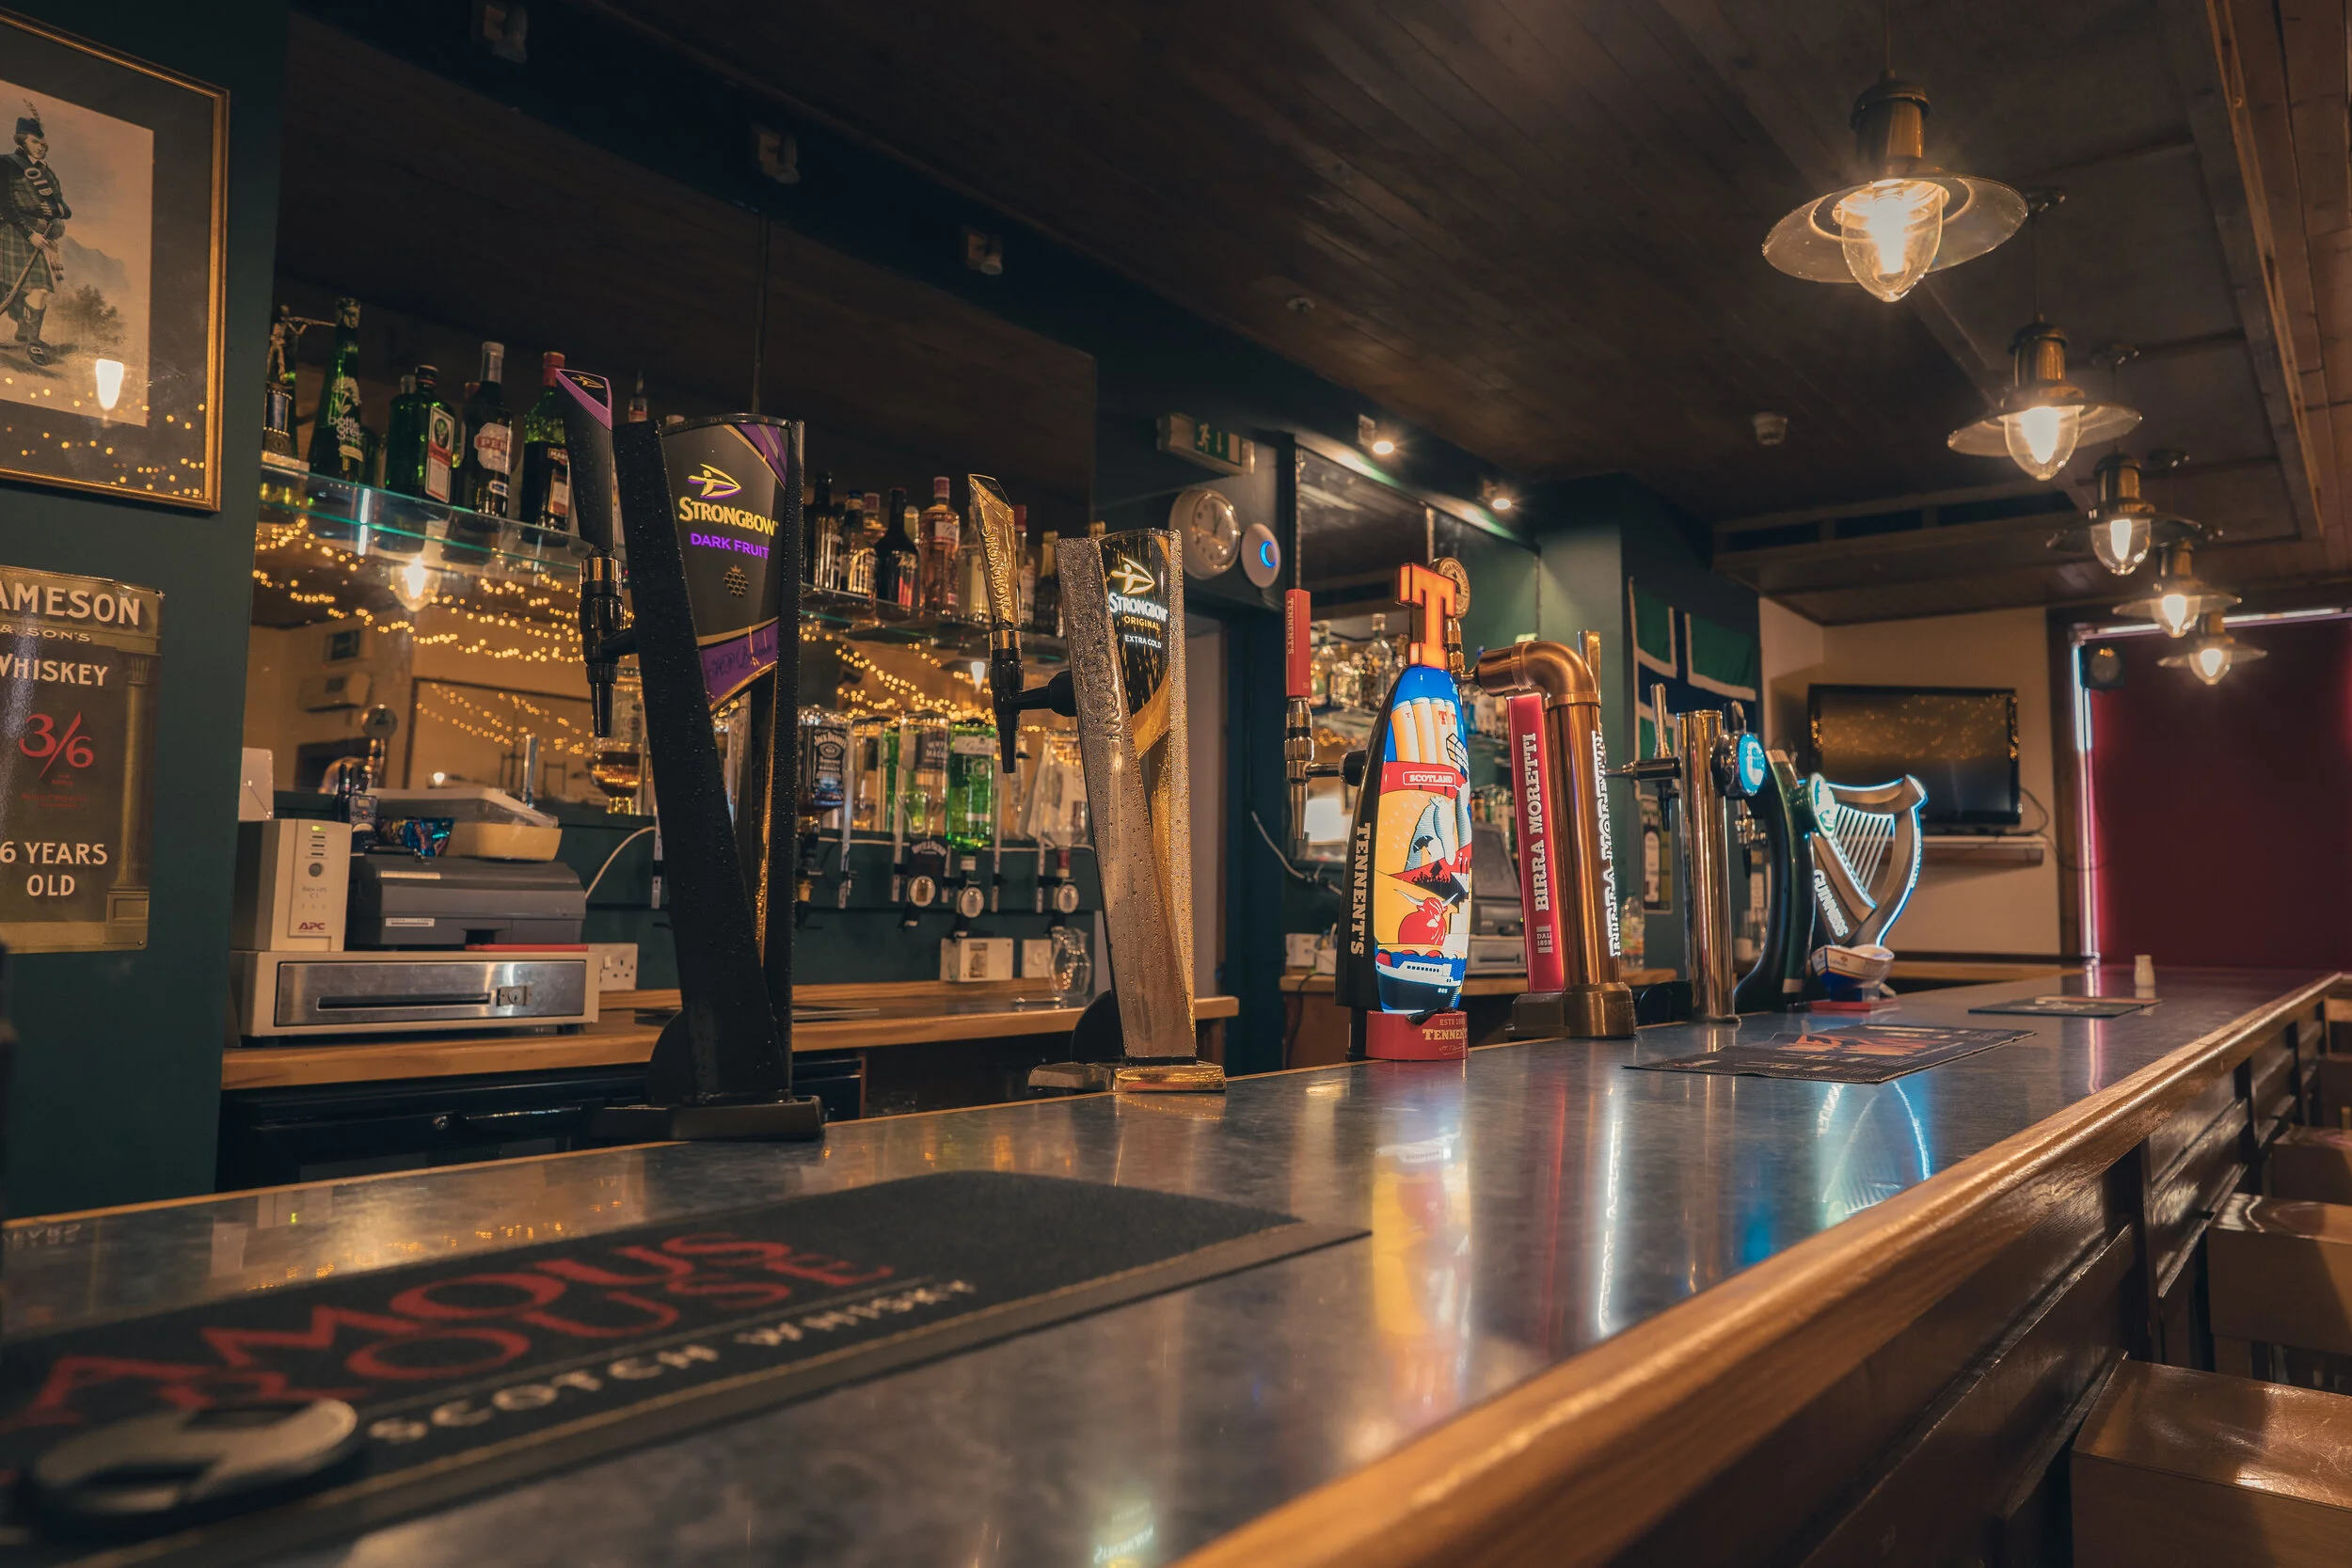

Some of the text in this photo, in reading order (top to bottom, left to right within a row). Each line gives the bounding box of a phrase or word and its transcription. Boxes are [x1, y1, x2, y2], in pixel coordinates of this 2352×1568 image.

[678, 496, 776, 536] STRONGBOW
[690, 531, 770, 560] DARK FRUIT
[981, 523, 1013, 611] STRONGBOW
[1108, 592, 1168, 622] STRONGBOW
[1397, 562, 1457, 670] T
[26, 626, 91, 642] SON'S
[1123, 615, 1161, 631] ORIGINAL
[1124, 634, 1162, 649] EXTRA COLD
[18, 711, 94, 780] 3/6
[1408, 773, 1454, 784] SCOTLAND
[1521, 732, 1549, 912] BIRRA MORETTI
[24, 842, 108, 865] YEARS
[26, 874, 75, 896] OLD
[1350, 822, 1371, 955] TENNENT'S
[1813, 869, 1849, 938] GUINNESS
[298, 922, 326, 930] APC
[367, 1344, 721, 1444] SCOTCH
